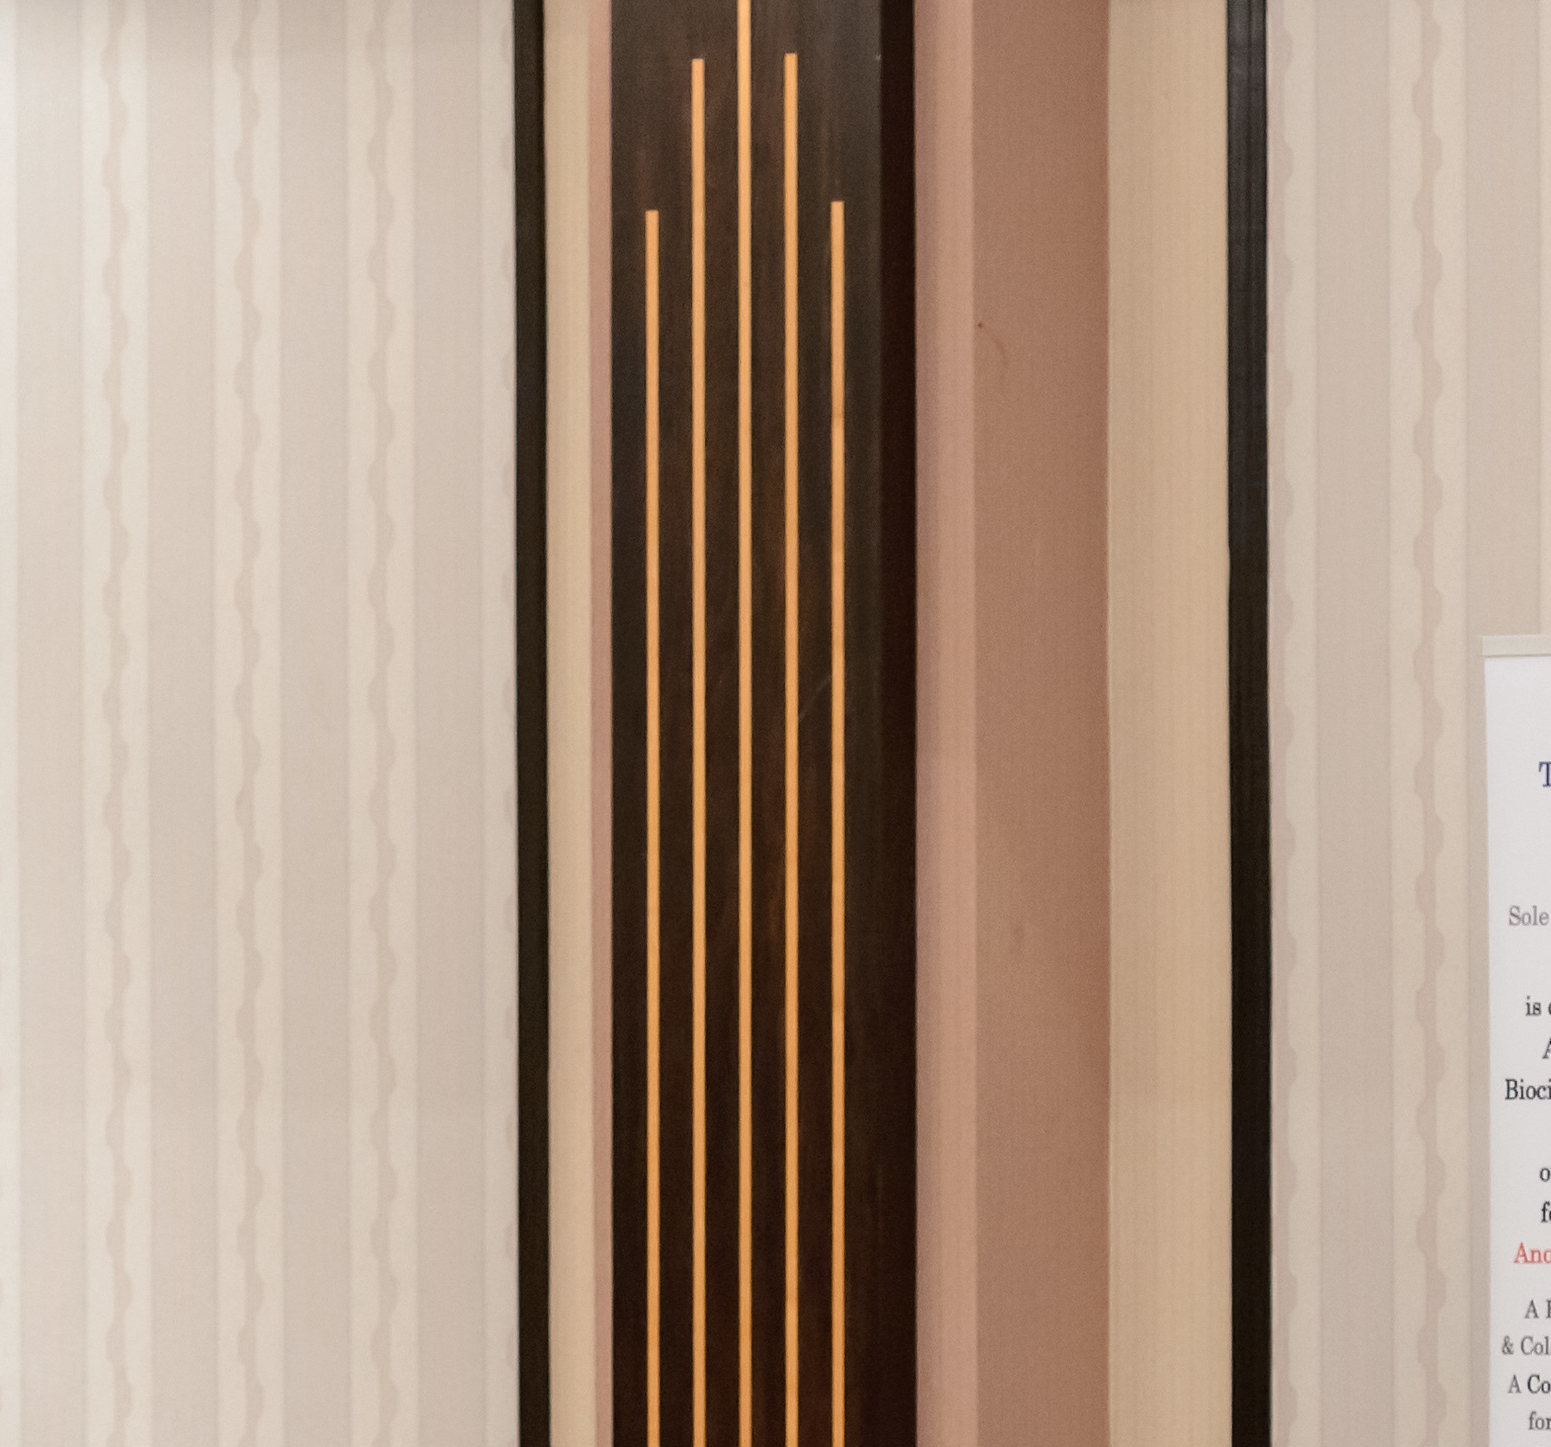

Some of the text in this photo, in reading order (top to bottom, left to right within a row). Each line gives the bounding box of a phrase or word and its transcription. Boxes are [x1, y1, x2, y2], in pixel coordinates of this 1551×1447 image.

[1509, 905, 1549, 926] Sole
[1526, 996, 1541, 1016] is
[1525, 1299, 1539, 1319] A
[1502, 1336, 1514, 1355] &
[1508, 1374, 1522, 1393] A
